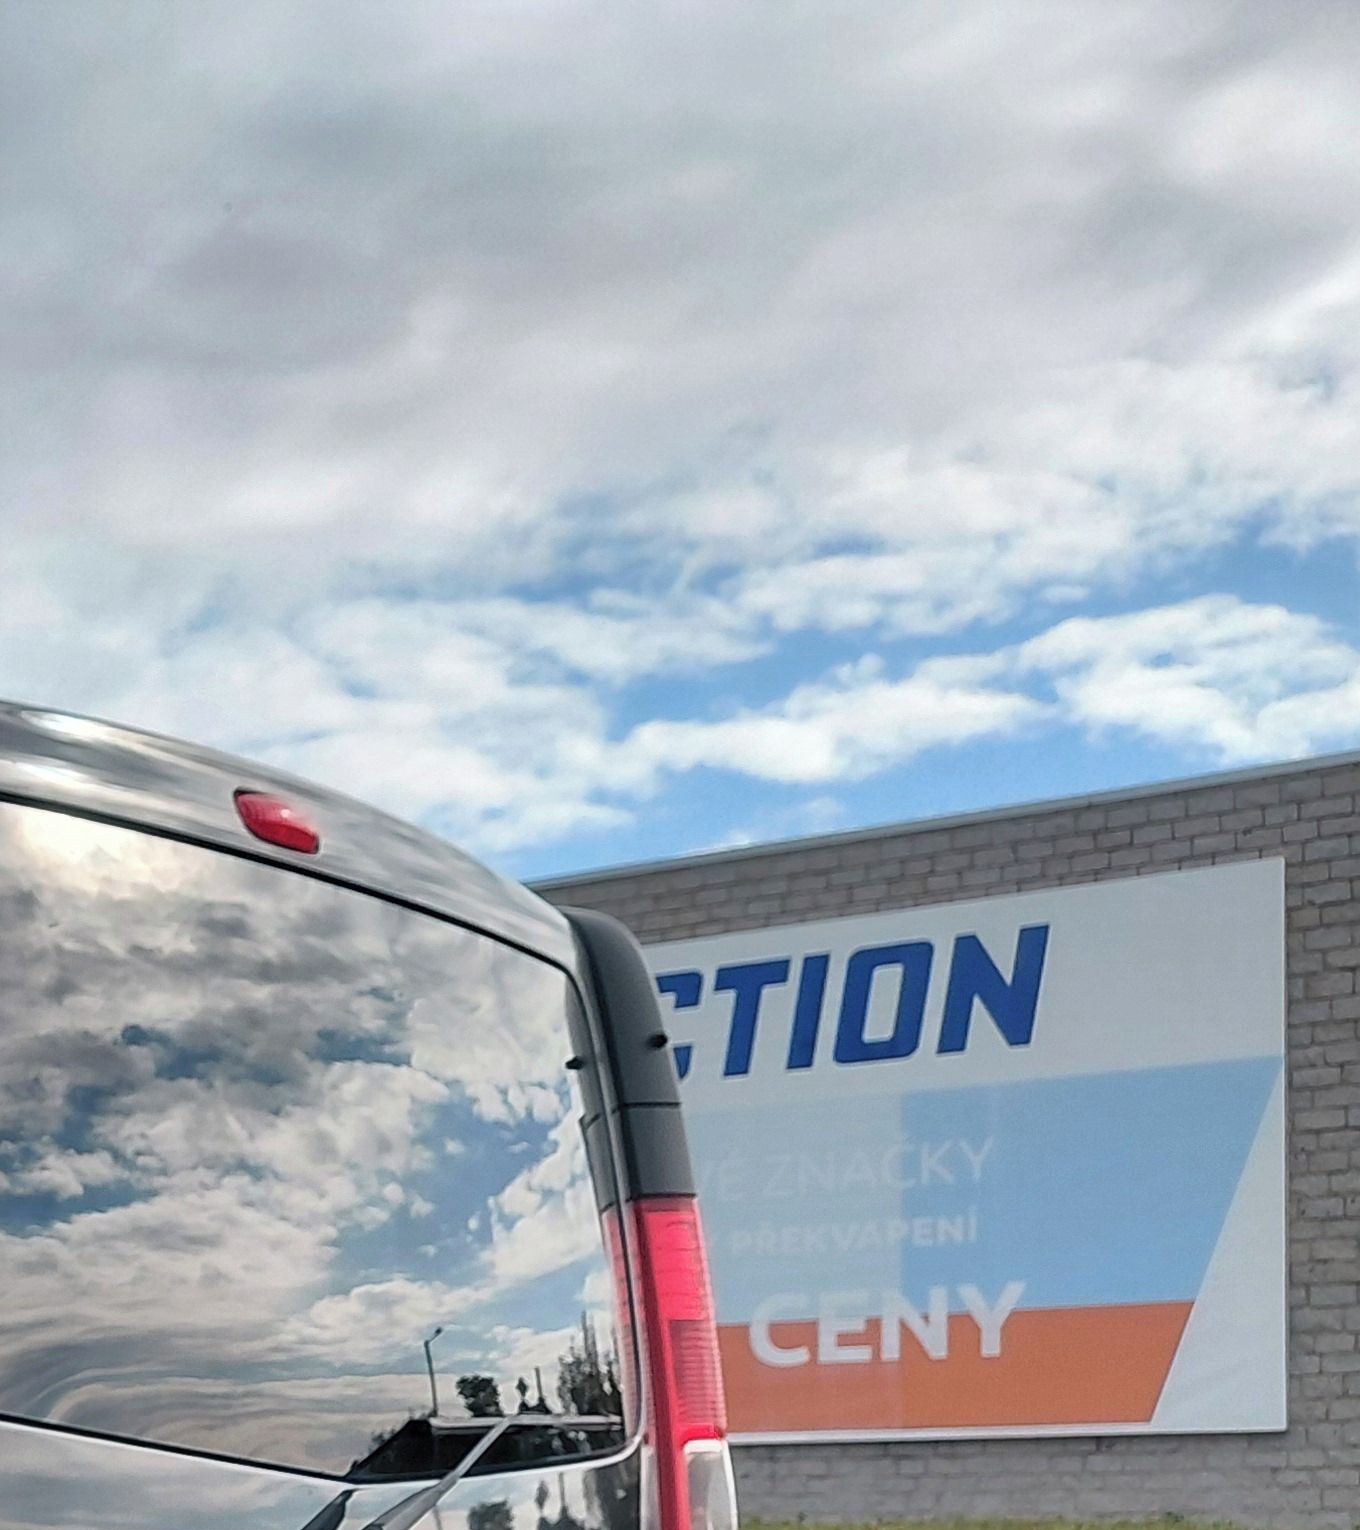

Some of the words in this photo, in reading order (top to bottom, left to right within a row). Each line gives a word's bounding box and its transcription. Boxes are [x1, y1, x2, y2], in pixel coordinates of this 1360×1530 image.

[762, 1132, 994, 1198] ZNAČKY
[732, 1205, 978, 1256] PŘEKVAPENÍ
[748, 1281, 1026, 1368] CENY
